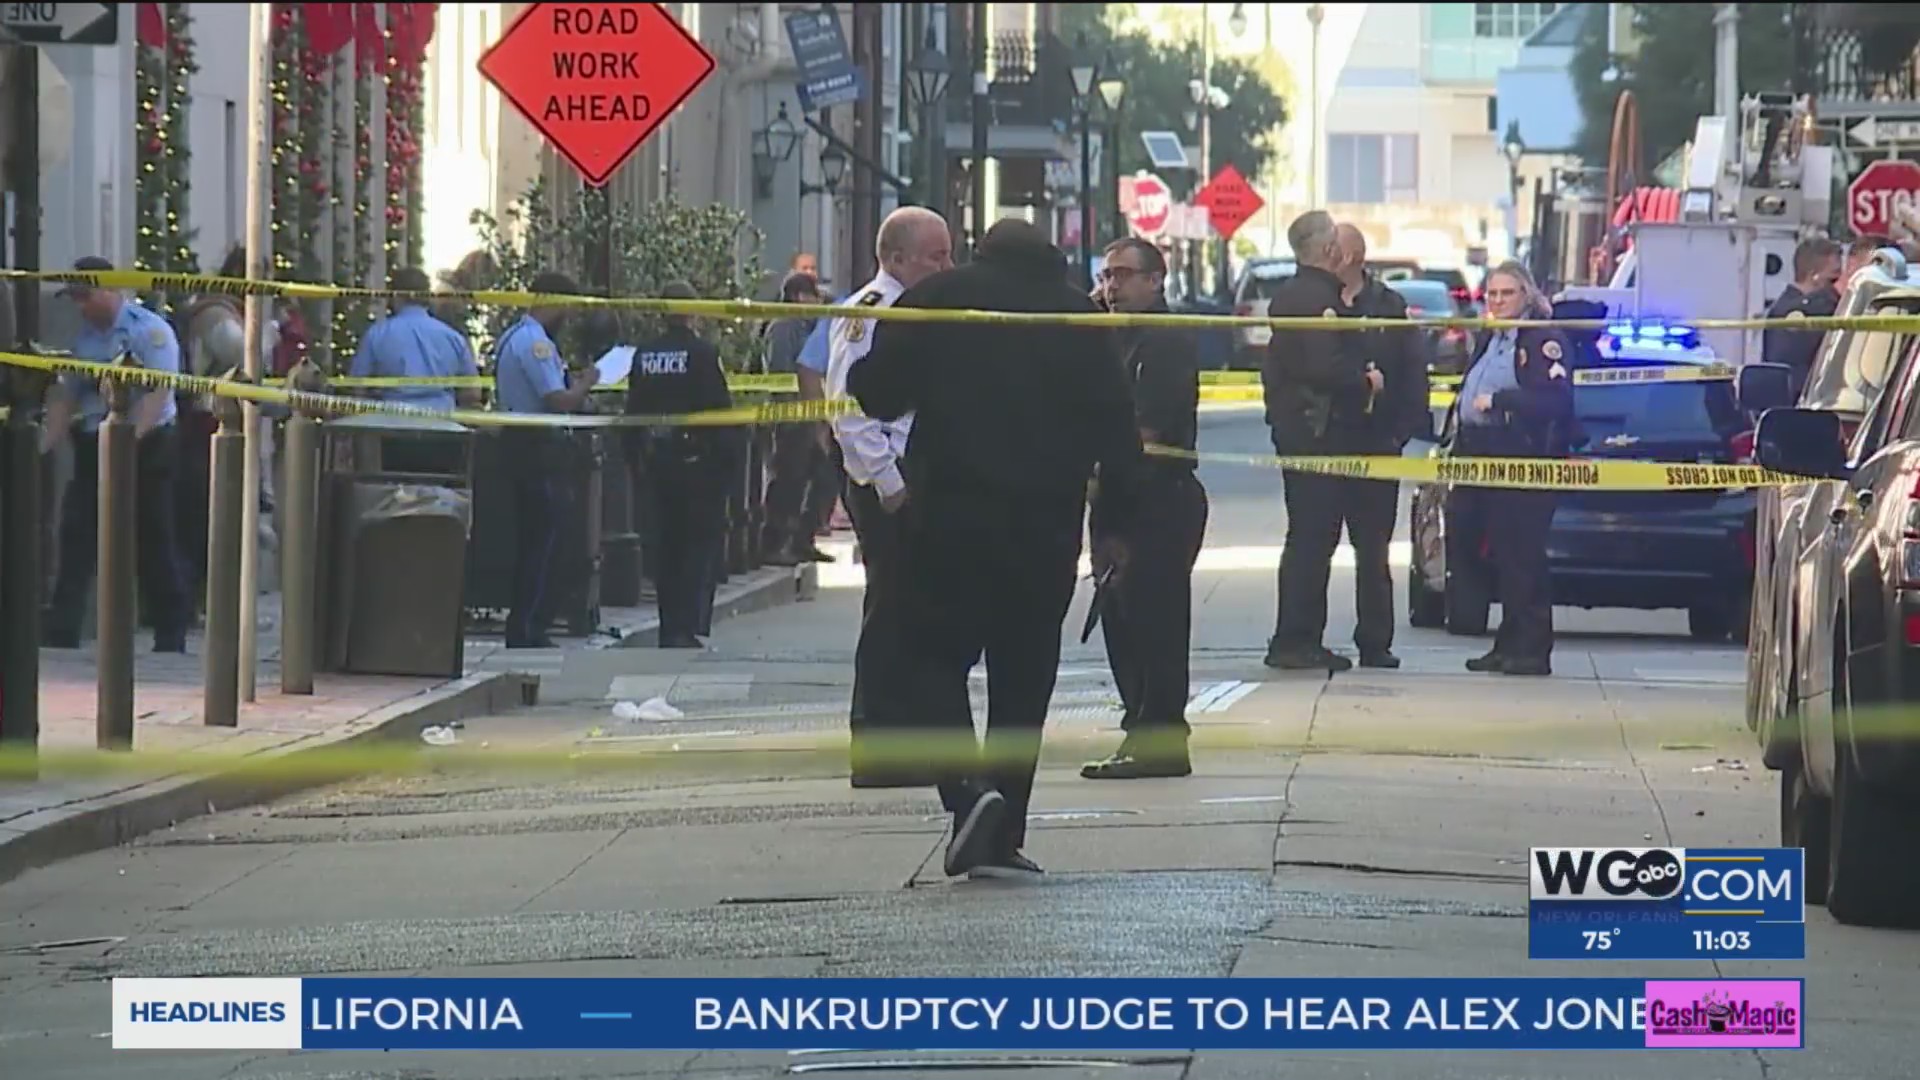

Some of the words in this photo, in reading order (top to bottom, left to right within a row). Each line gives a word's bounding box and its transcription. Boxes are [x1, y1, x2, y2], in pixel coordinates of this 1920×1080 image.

[553, 7, 639, 35] ROAD
[552, 51, 640, 79] WORK
[543, 94, 651, 121] AHEAD
[641, 359, 688, 375] POLICE
[1436, 463, 1479, 481] CROSS
[1480, 463, 1506, 482] NOT
[1508, 463, 1526, 482] DO
[1528, 463, 1554, 484] LINE
[1556, 463, 1599, 485] POLICE
[1666, 466, 1709, 486] CROSS
[1712, 466, 1737, 485] NOT
[1738, 467, 1757, 484] DO
